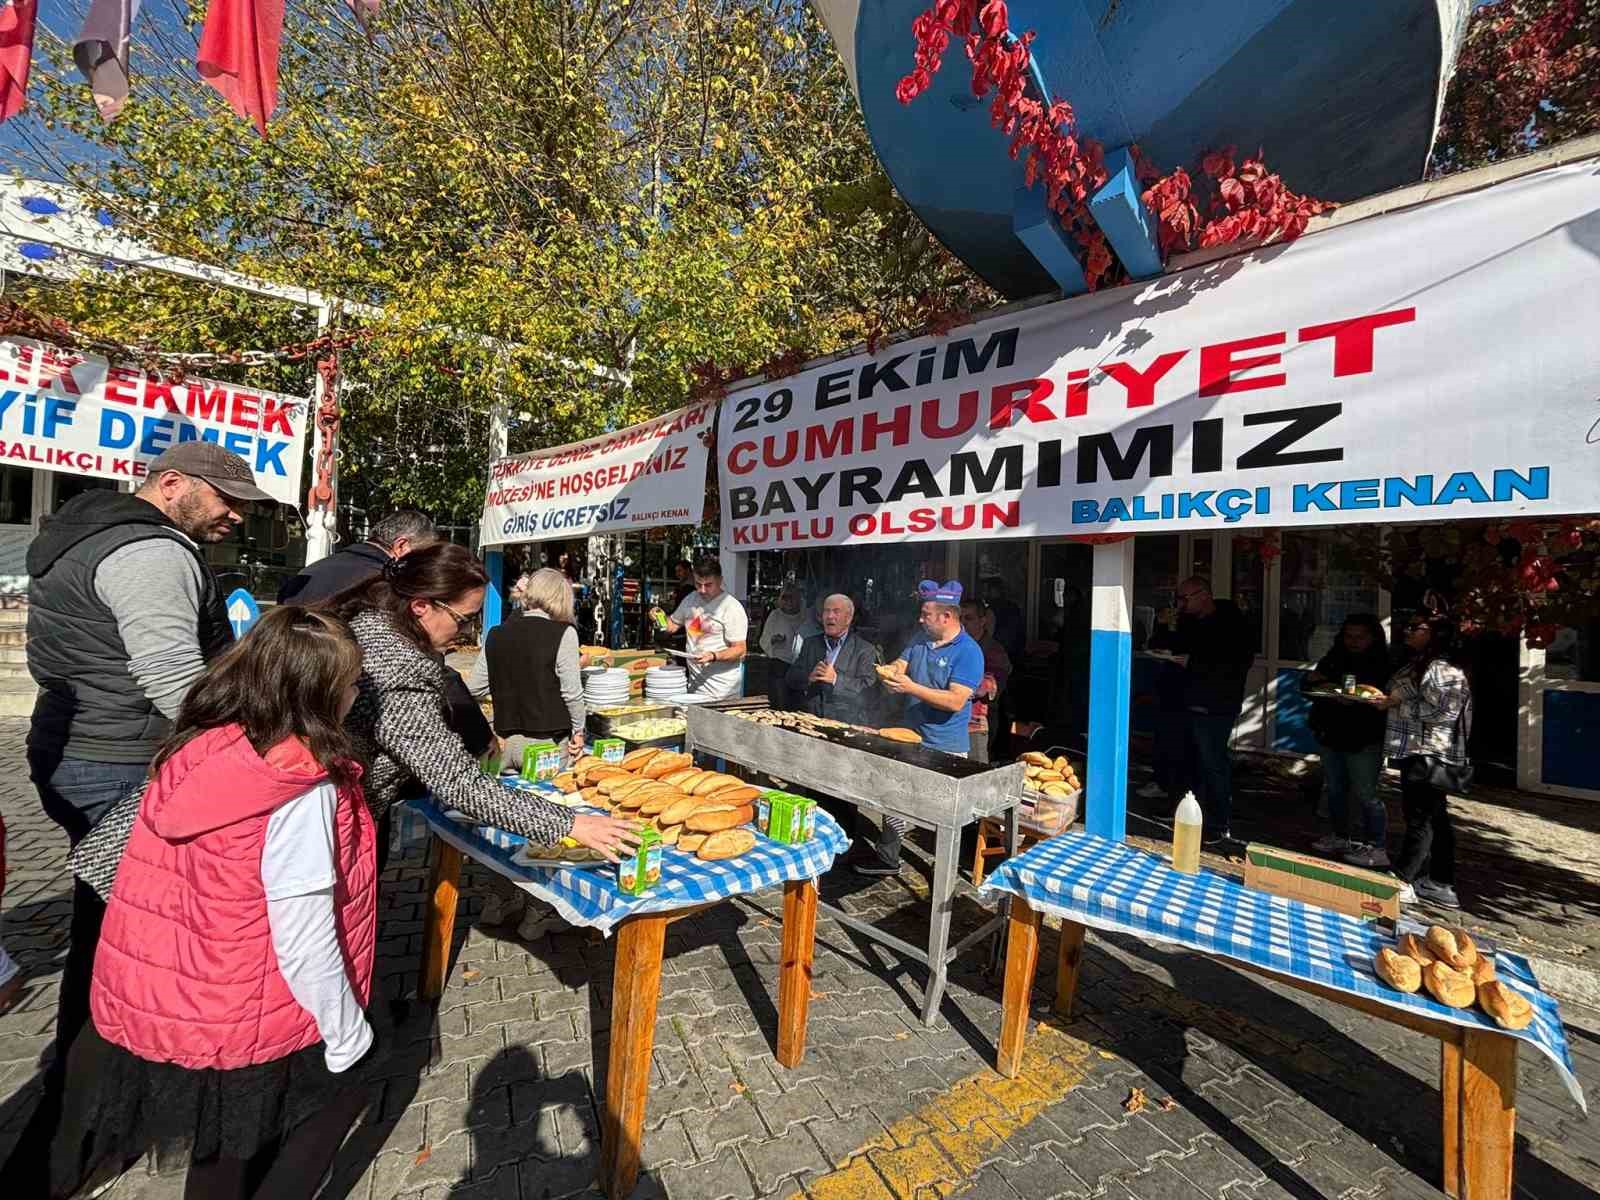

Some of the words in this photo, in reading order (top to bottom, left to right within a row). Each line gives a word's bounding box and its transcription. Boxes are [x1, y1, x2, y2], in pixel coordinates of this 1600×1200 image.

[104, 367, 295, 437] EKMEK
[733, 388, 793, 433] 29
[729, 402, 1343, 520] BAYRAMIMIZ
[660, 507, 689, 519] KENAN
[1072, 487, 1270, 523] BALIKÇI
[1292, 466, 1550, 512] KENAN
[733, 517, 834, 545] KUTLU
[849, 501, 1020, 536] OLSUN
